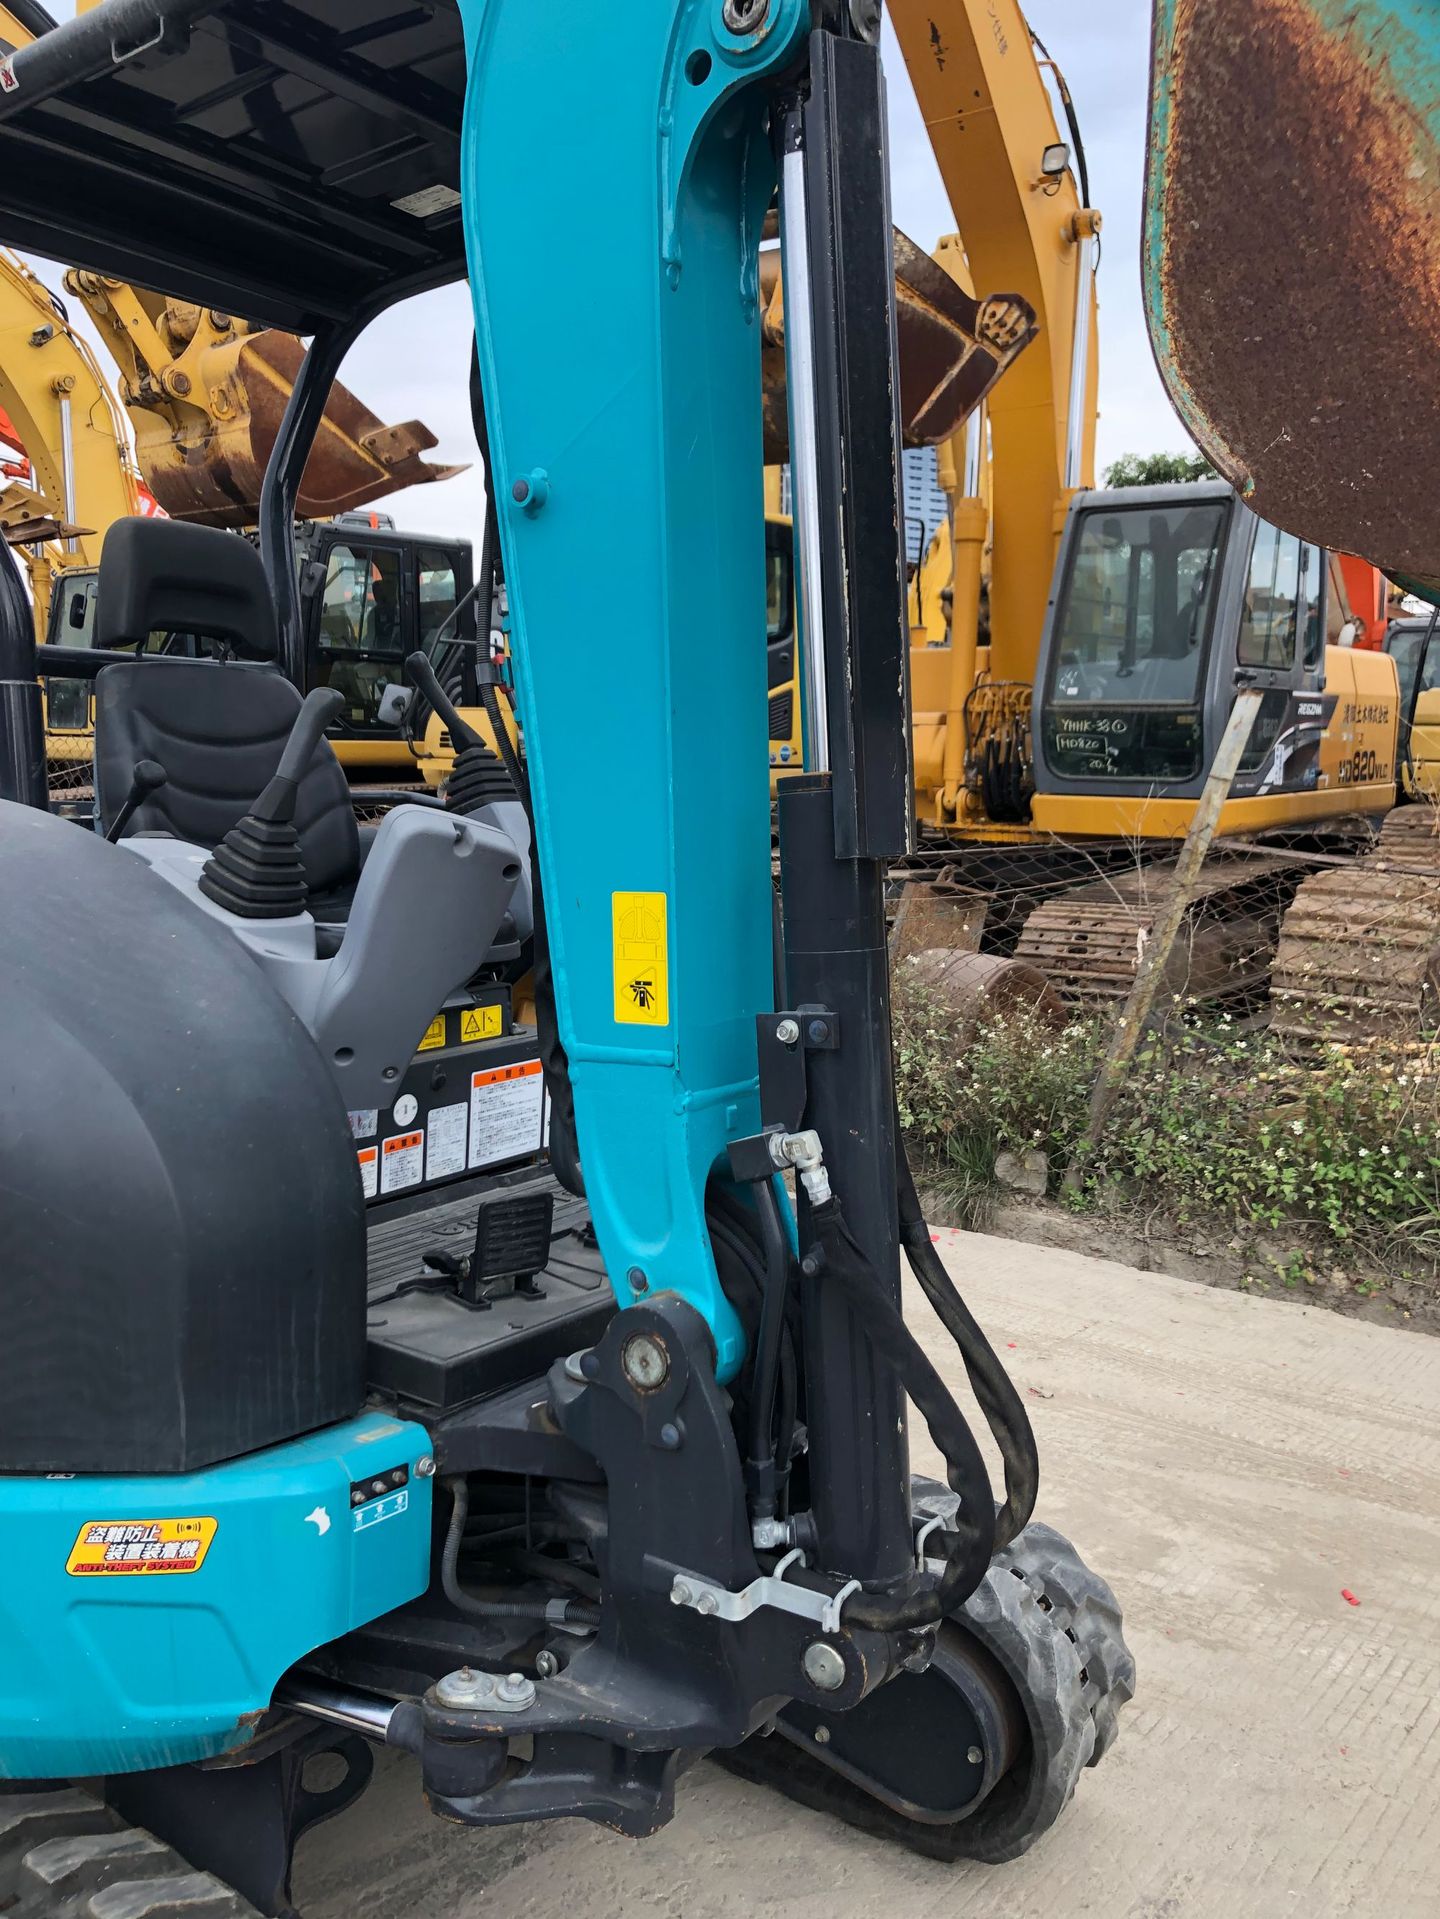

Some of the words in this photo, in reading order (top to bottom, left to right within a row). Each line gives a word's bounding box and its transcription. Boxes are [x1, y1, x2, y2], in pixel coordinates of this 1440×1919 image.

[86, 1525, 160, 1544] 盗難防止
[105, 1540, 200, 1561] 装置装着機
[73, 1562, 146, 1573] ANTI-THEFT
[145, 1560, 197, 1571] SYSTEM
